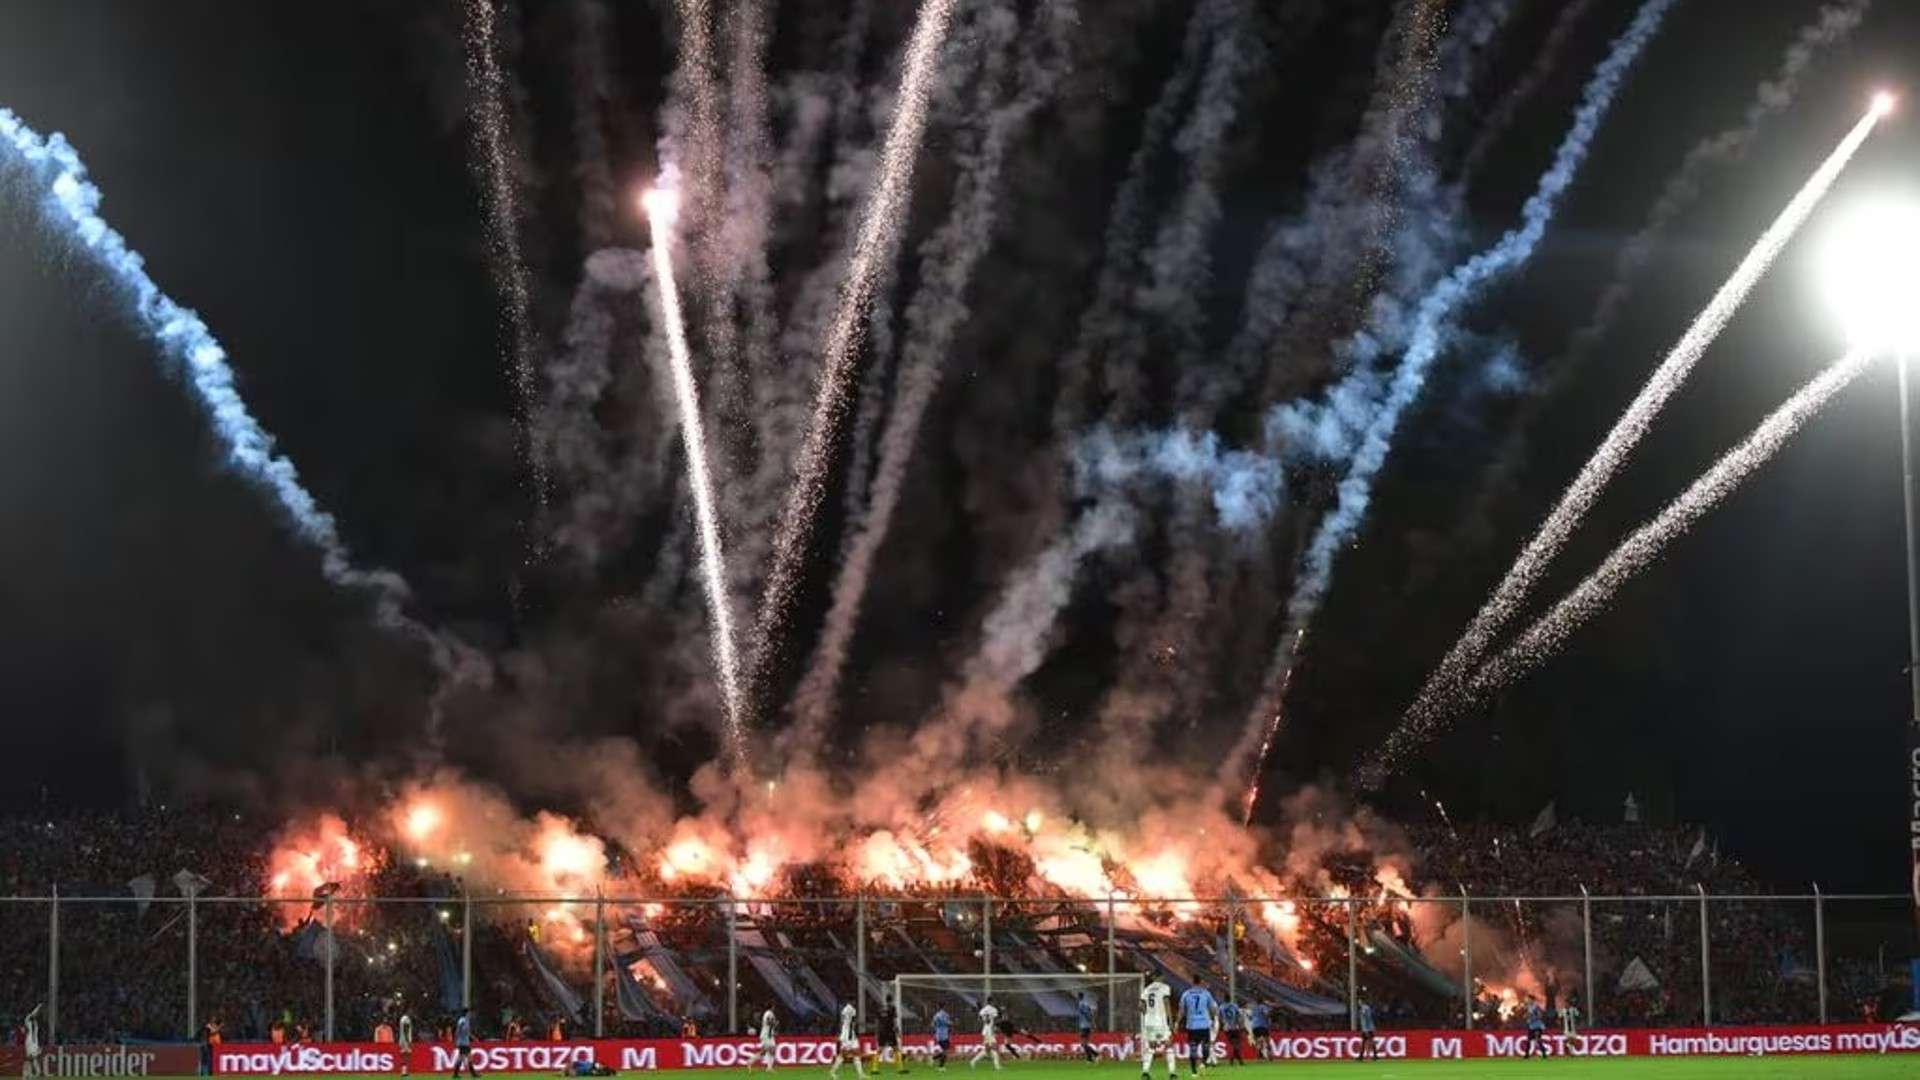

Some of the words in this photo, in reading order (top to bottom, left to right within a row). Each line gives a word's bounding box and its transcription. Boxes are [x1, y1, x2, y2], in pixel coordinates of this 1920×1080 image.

[1148, 993, 1156, 1008] 6
[1191, 995, 1201, 1010] 7
[1650, 1032, 1832, 1056] Hamburguesas
[33, 1045, 155, 1077] chneider
